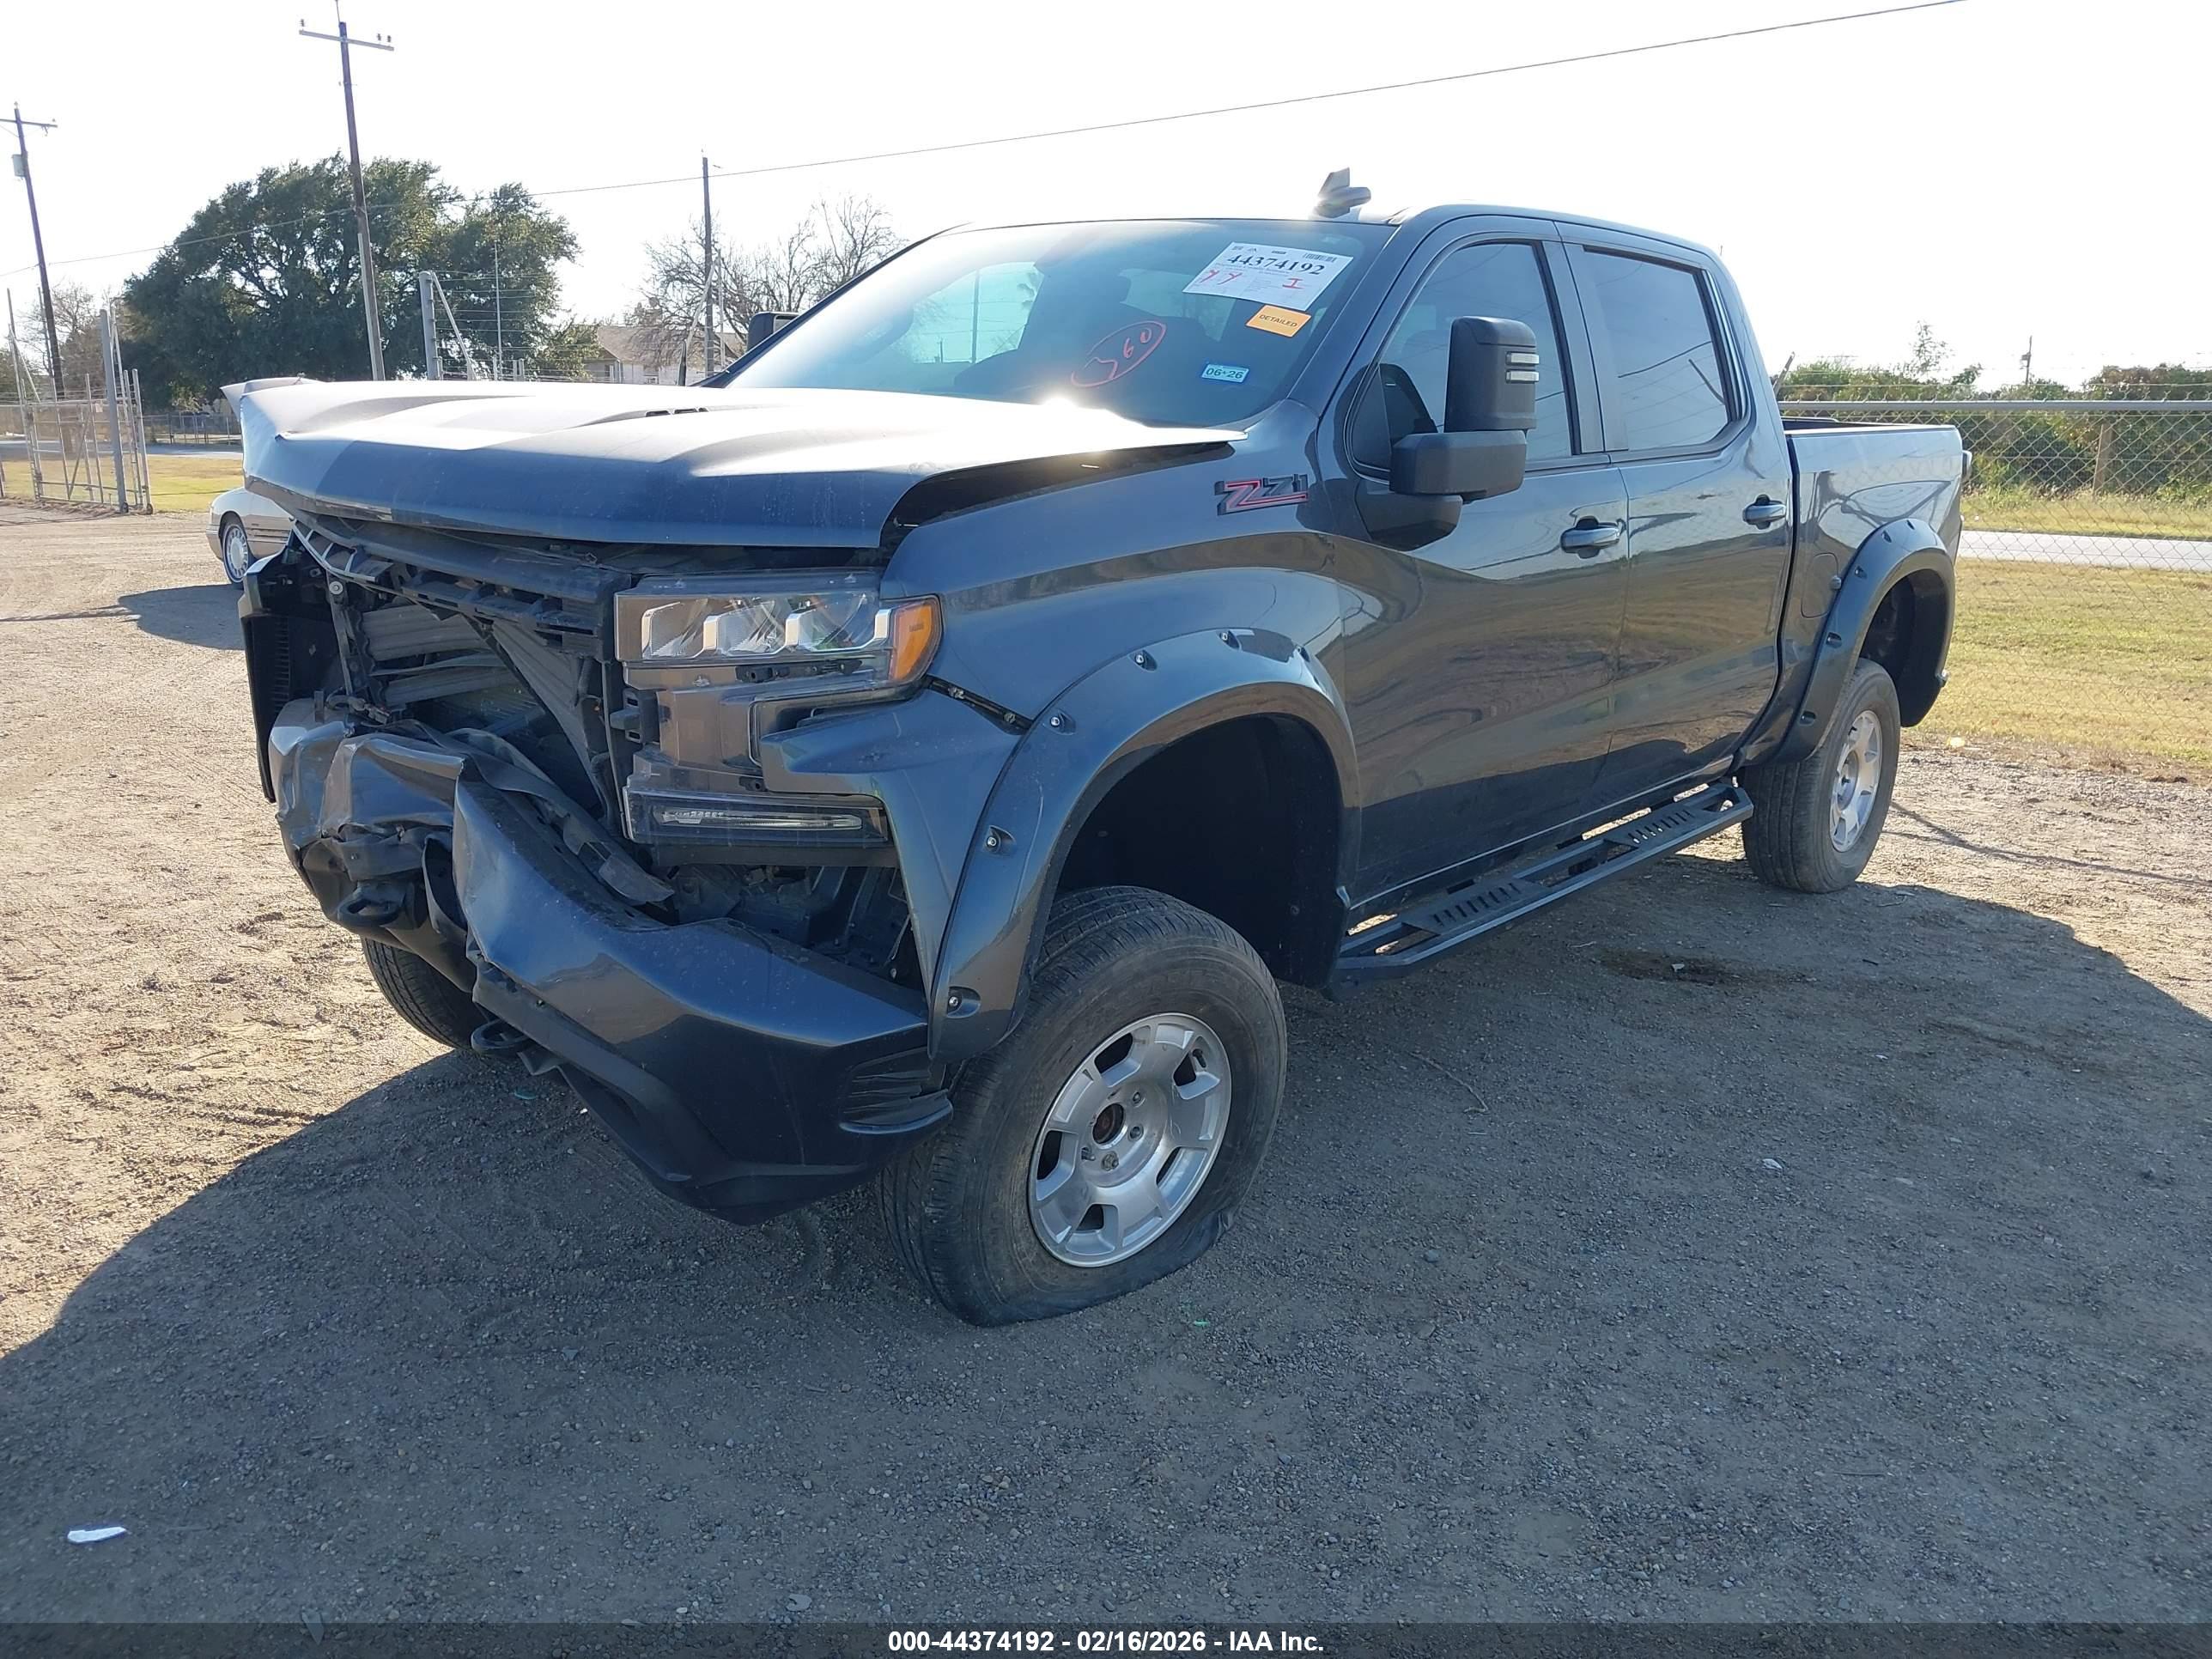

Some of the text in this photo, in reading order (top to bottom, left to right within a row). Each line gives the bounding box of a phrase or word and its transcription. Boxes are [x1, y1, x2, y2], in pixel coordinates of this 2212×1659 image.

[1228, 254, 1325, 275] 44374192
[1259, 314, 1297, 327] DETAILED
[1214, 474, 1308, 515] Z71
